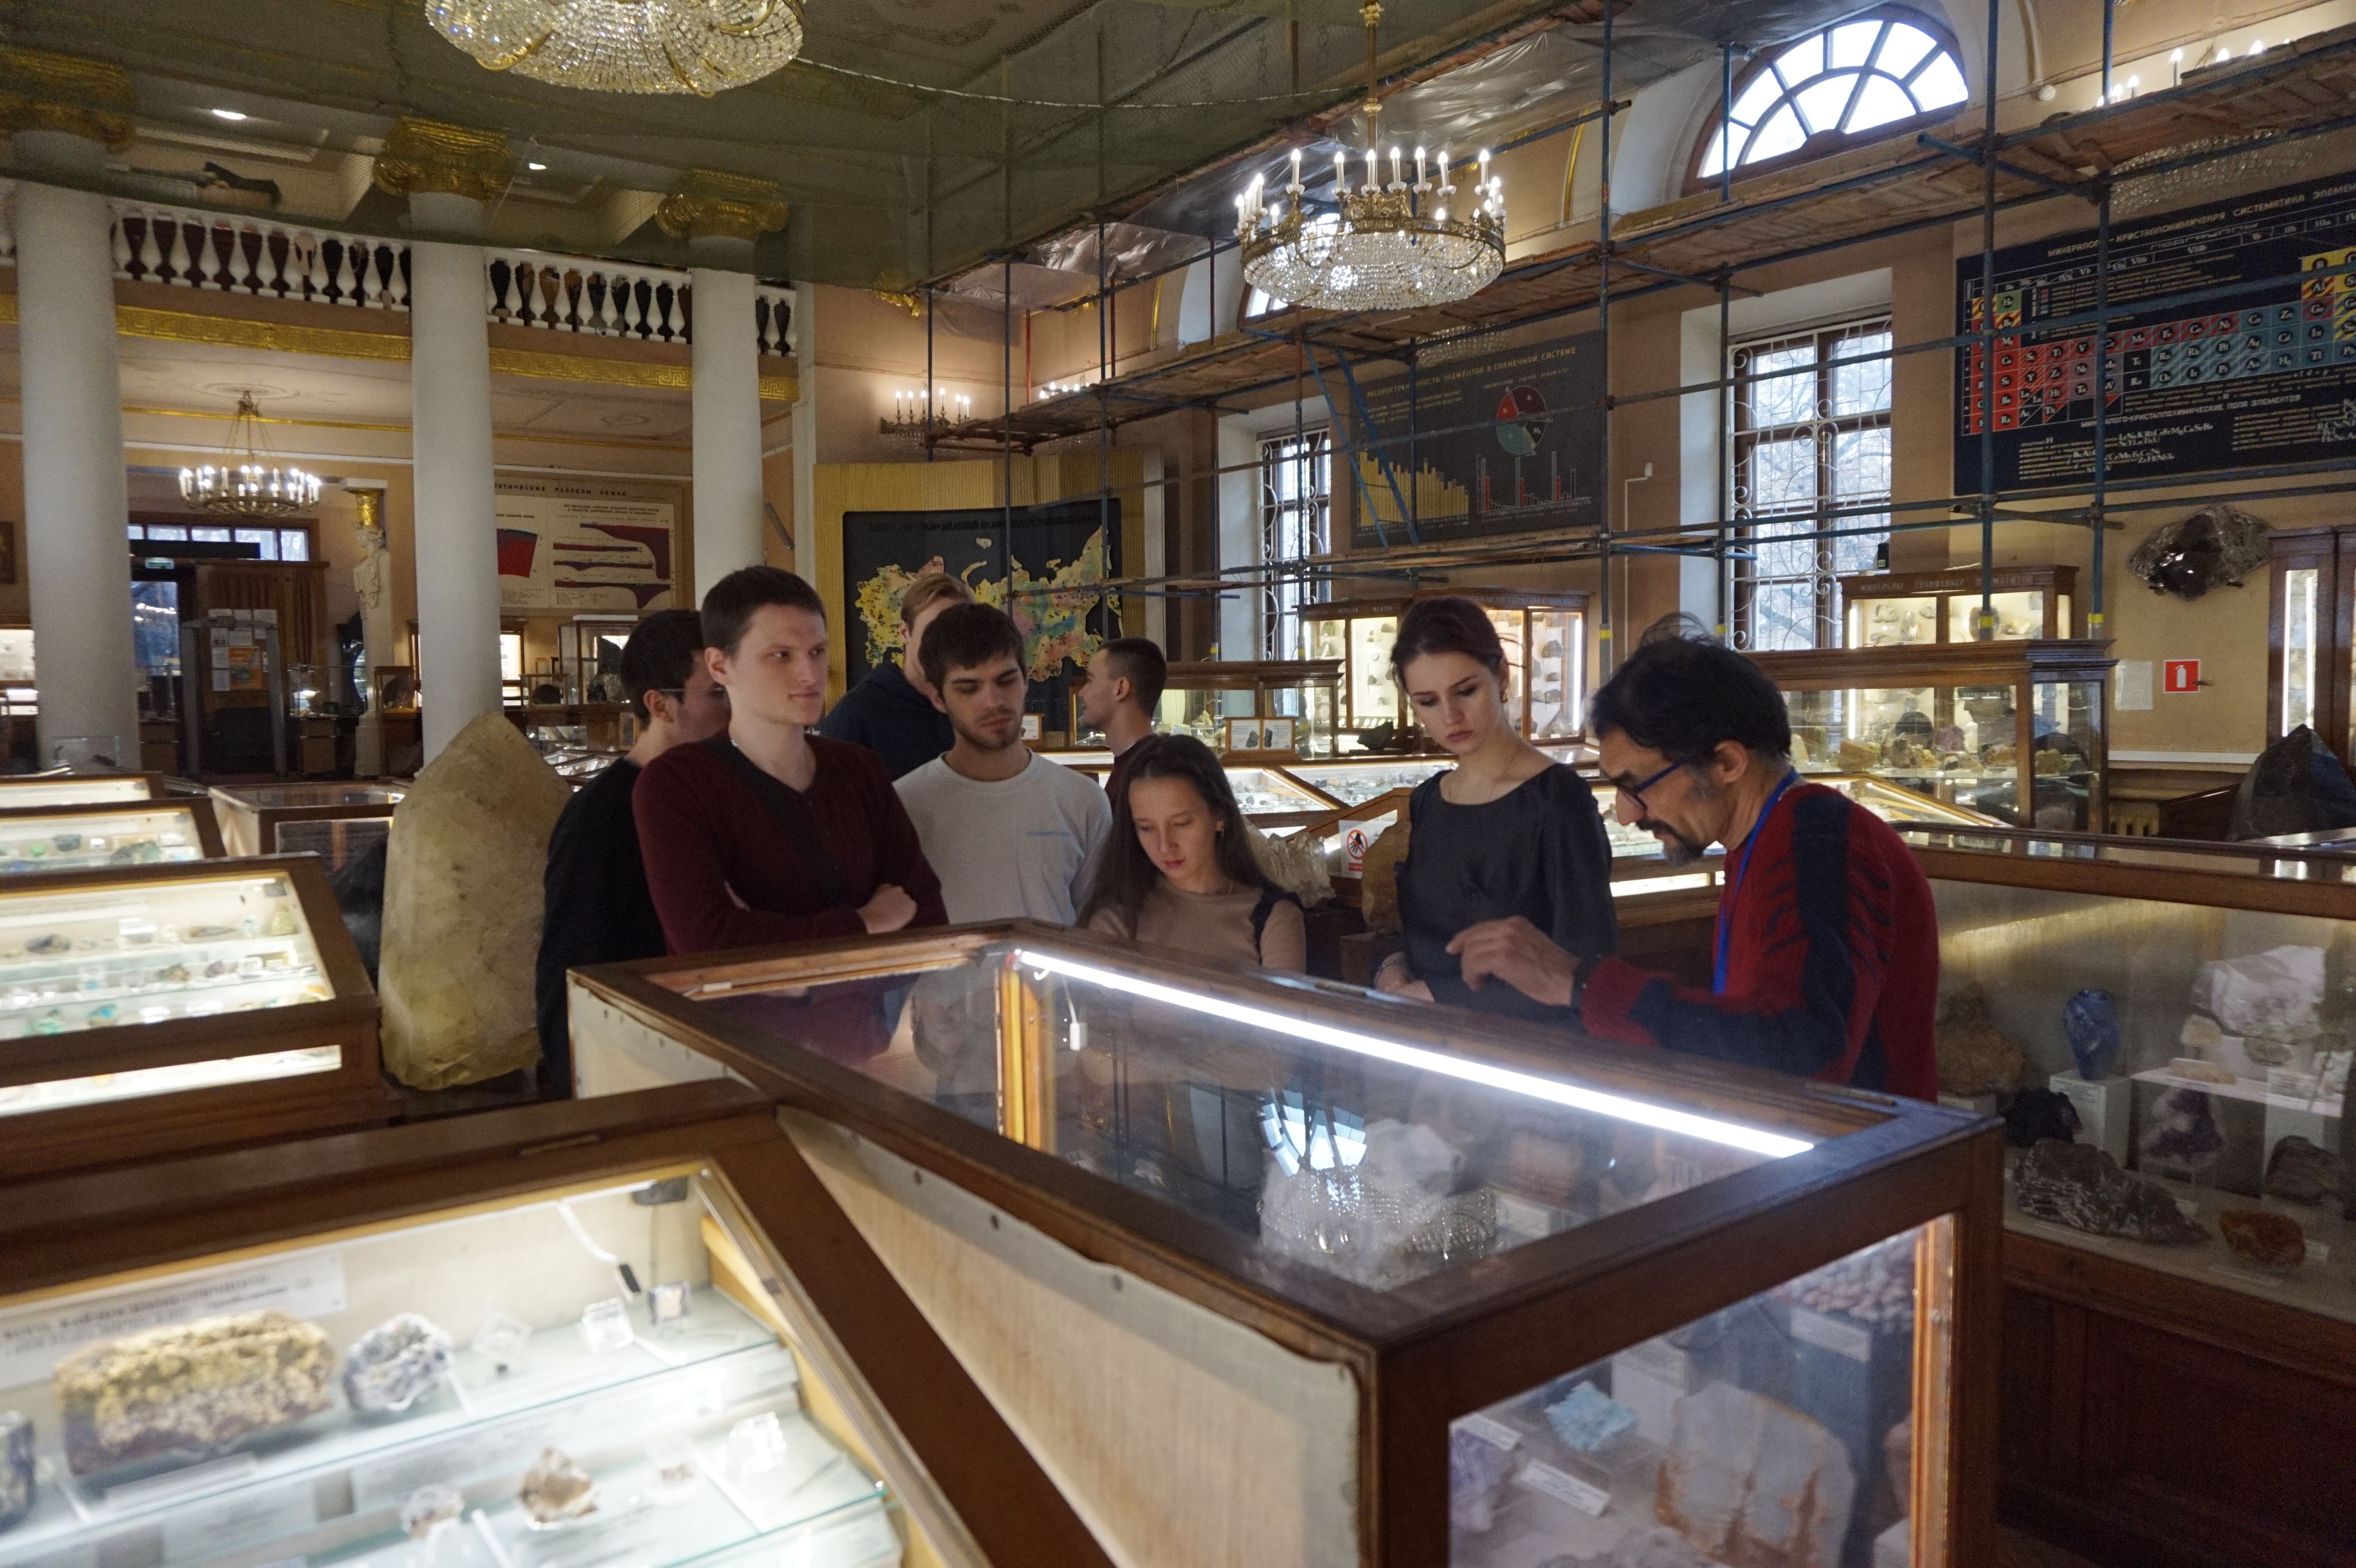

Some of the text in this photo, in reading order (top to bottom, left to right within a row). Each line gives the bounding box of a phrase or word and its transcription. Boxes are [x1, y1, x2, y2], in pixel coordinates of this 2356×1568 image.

[2232, 194, 2305, 216] СИСТЕМАТИКА
[2313, 283, 2325, 292] Al
[2003, 296, 2013, 306] He
[2052, 348, 2062, 357] Ti
[2078, 344, 2086, 352] V
[2132, 334, 2145, 344] Mn
[2162, 329, 2172, 339] Fe
[1444, 366, 1484, 381] ЭЛЕМЕНТОВ
[1494, 355, 1538, 370] СОЛНЕЧНОЙ
[1541, 347, 1576, 360] СИСТЕМЕ
[2001, 377, 2011, 386] Sr
[2027, 373, 2036, 382] Y
[2050, 370, 2061, 378] Zr
[2226, 401, 2248, 410] ПОЛЯ
[2251, 394, 2301, 407] ЭЛЕМЕНТОВ
[2001, 415, 2011, 424] Ra
[1860, 576, 2033, 591] МИНЕРАЛЫ ГРАНИТНЫХ ПМАТИТОВ
